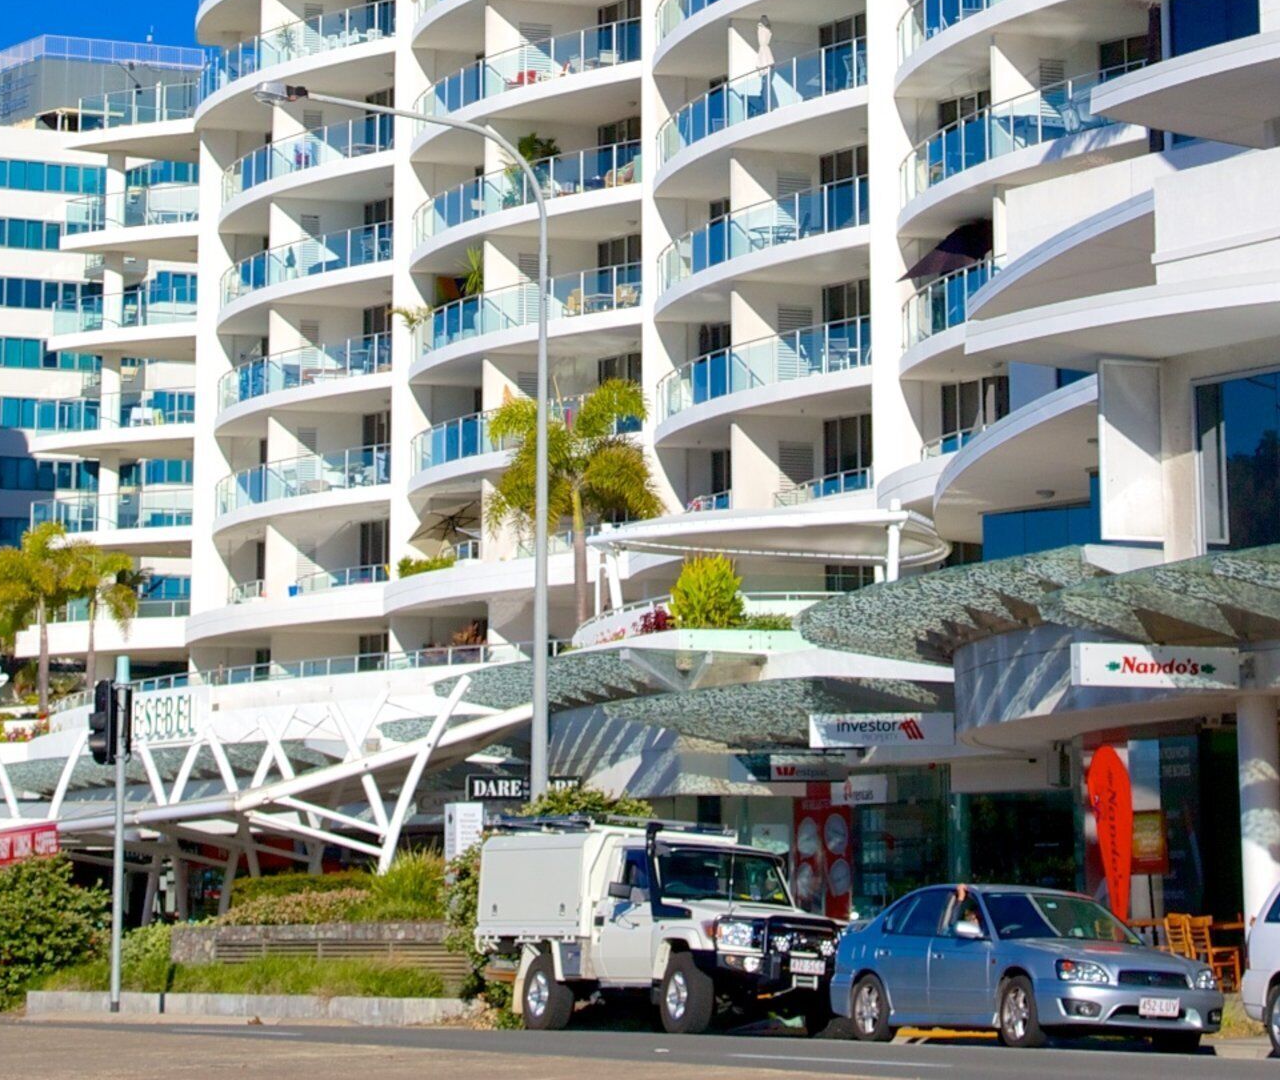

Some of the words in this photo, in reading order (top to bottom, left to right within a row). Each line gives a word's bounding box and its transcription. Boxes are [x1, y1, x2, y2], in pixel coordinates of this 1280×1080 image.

[1120, 655, 1200, 676] Nando's
[145, 694, 195, 739] SEBEL
[836, 718, 898, 733] investor
[473, 779, 523, 797] DARE
